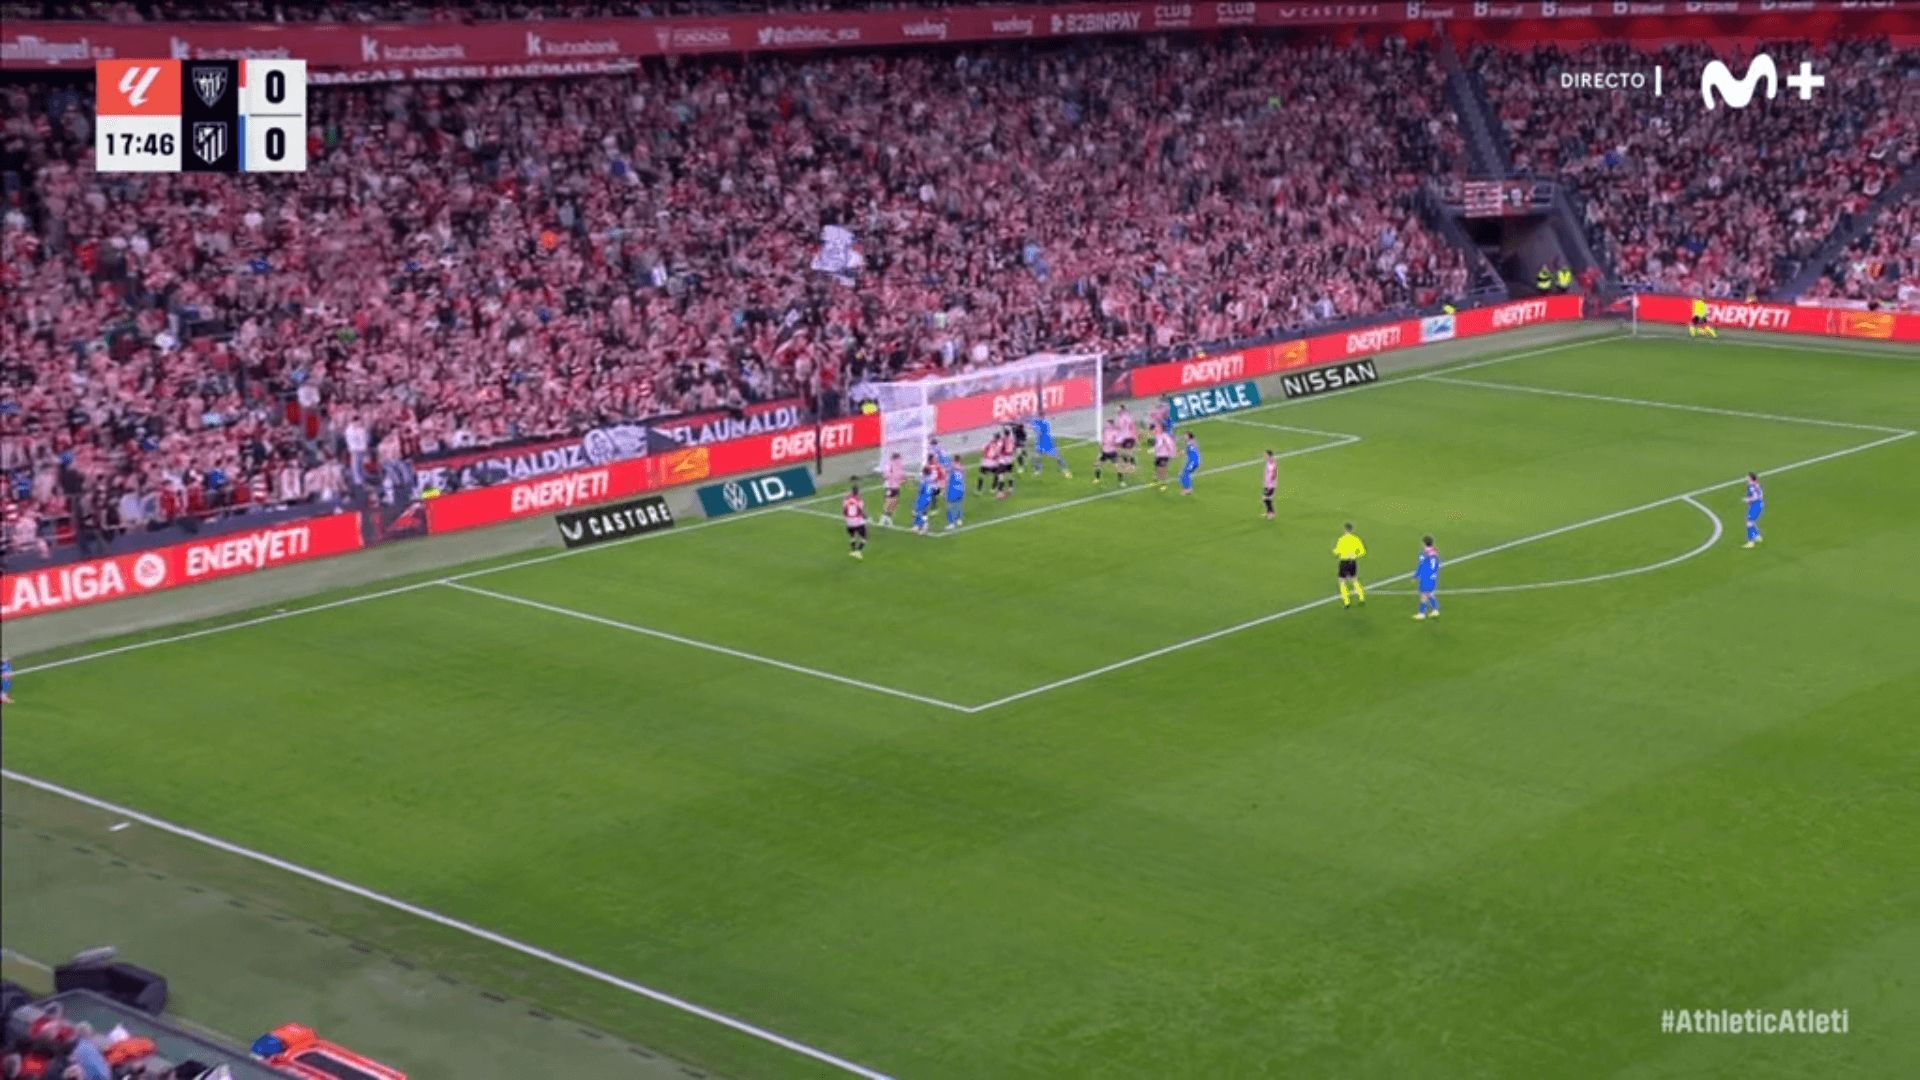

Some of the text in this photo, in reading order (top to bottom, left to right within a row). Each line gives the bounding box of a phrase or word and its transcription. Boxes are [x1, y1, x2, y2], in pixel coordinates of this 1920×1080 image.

[1065, 10, 1142, 33] B2BINPAY
[1154, 4, 1192, 18] CLUB
[1216, 2, 1255, 16] CLUB
[1301, 5, 1378, 16] CASTORE
[1492, 300, 1548, 328] ENERYETI
[1346, 325, 1401, 354] ENERYETI
[1181, 352, 1244, 385] ENERYETI
[1283, 361, 1377, 396] NISSAN
[1190, 384, 1253, 418] REALE
[511, 470, 609, 513] ENERYETI
[751, 475, 794, 504] ID.
[588, 503, 671, 536] CASTORE
[186, 526, 310, 577] ENERYETI
